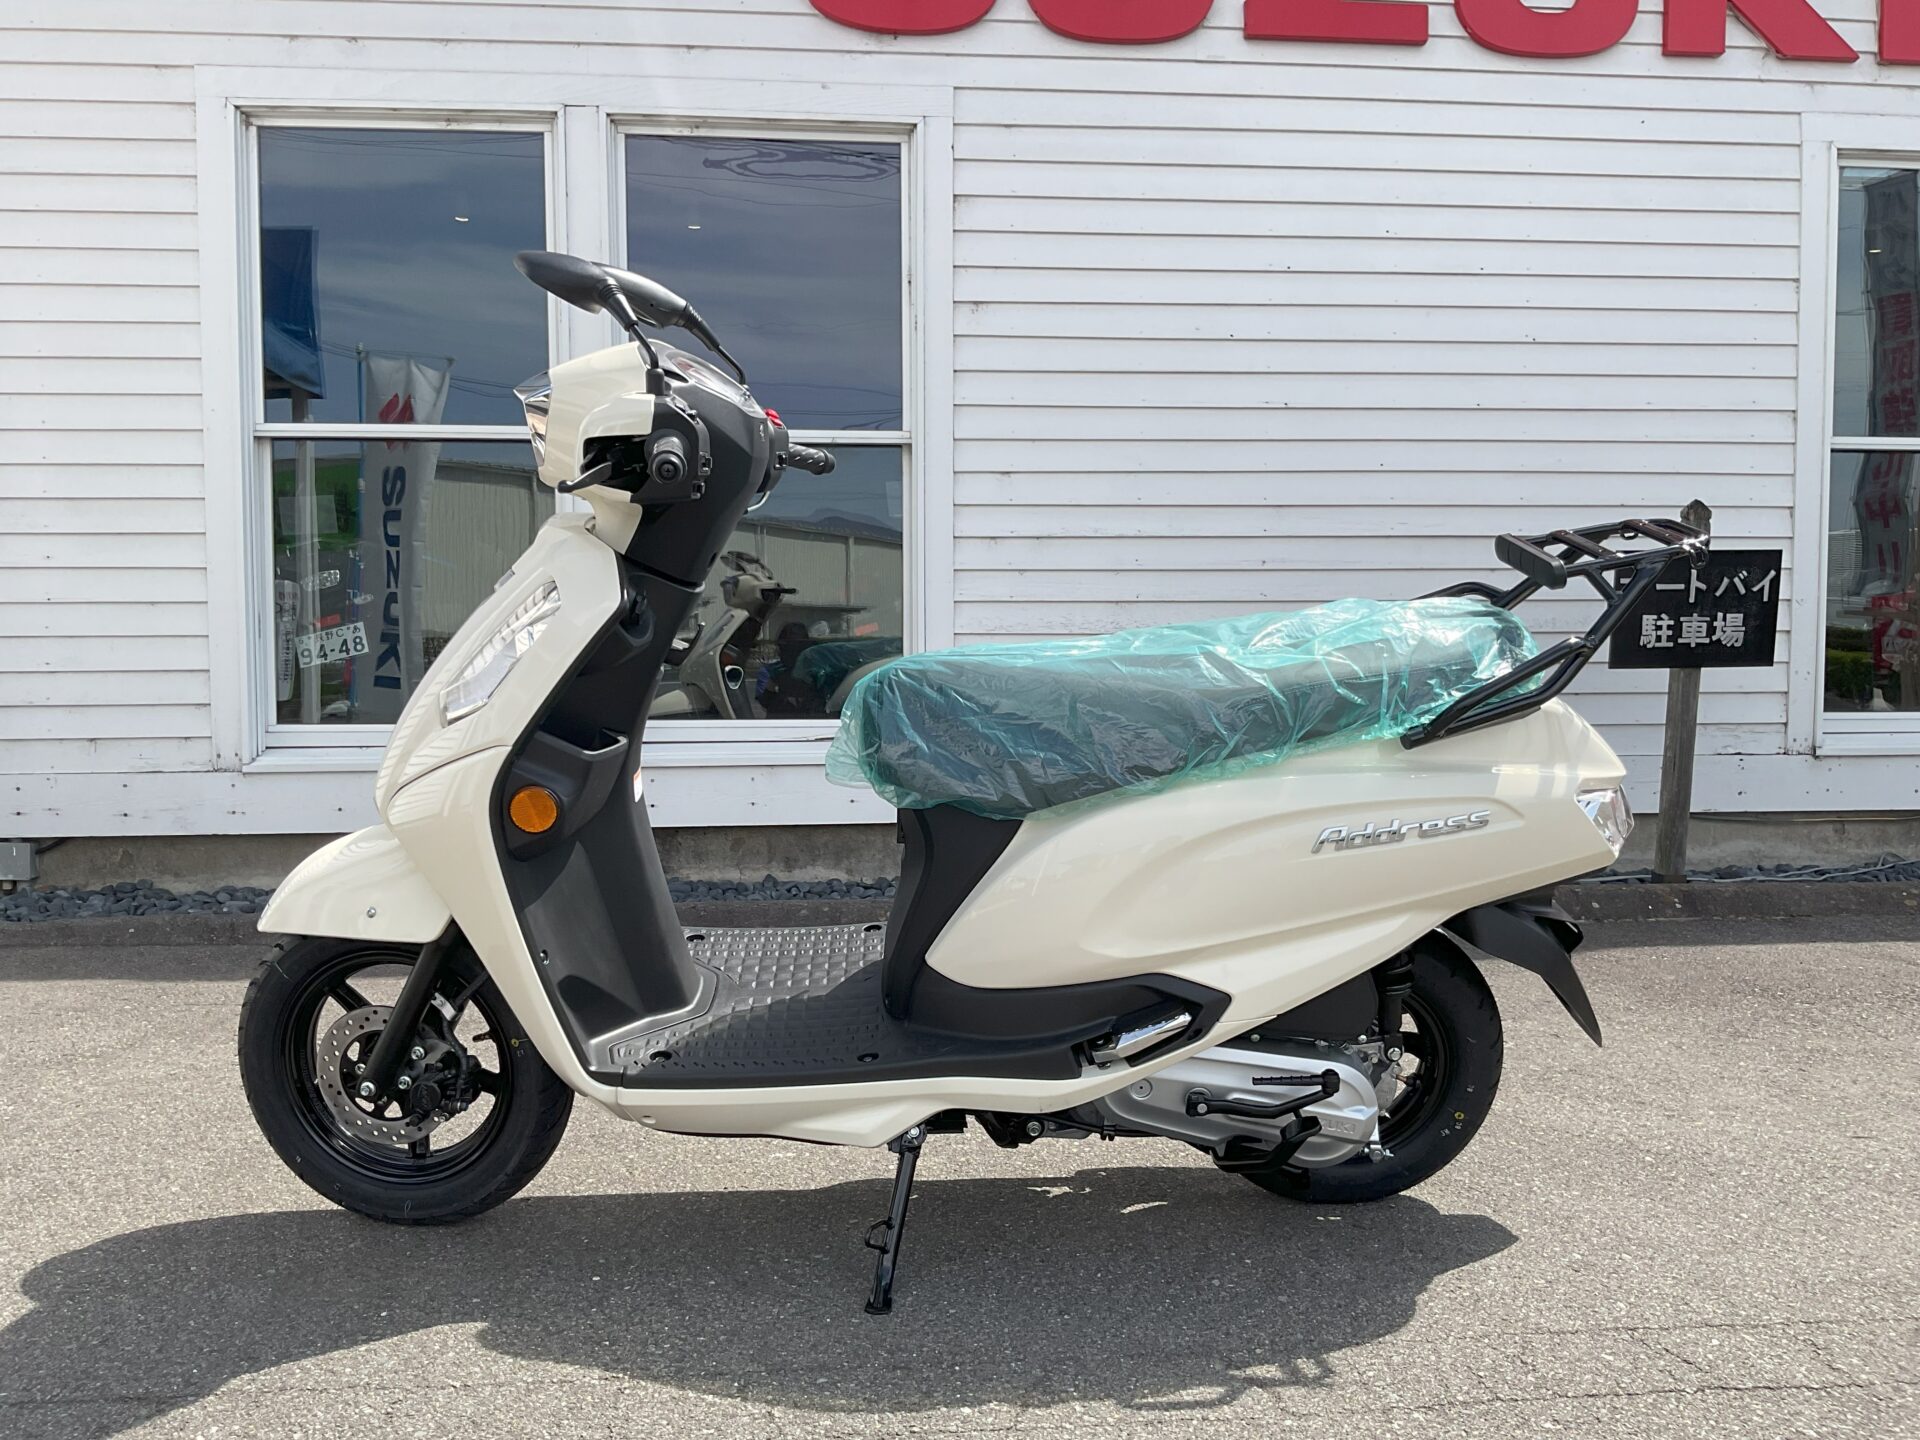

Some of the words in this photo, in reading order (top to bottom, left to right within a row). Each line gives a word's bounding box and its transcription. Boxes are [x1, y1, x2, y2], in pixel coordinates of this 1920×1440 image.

[373, 465, 407, 690] SUZUKI
[1619, 569, 1776, 604] ートバイ
[1639, 612, 1746, 648] 駐車場
[300, 635, 366, 666] 94-48
[1310, 810, 1491, 854] Address
